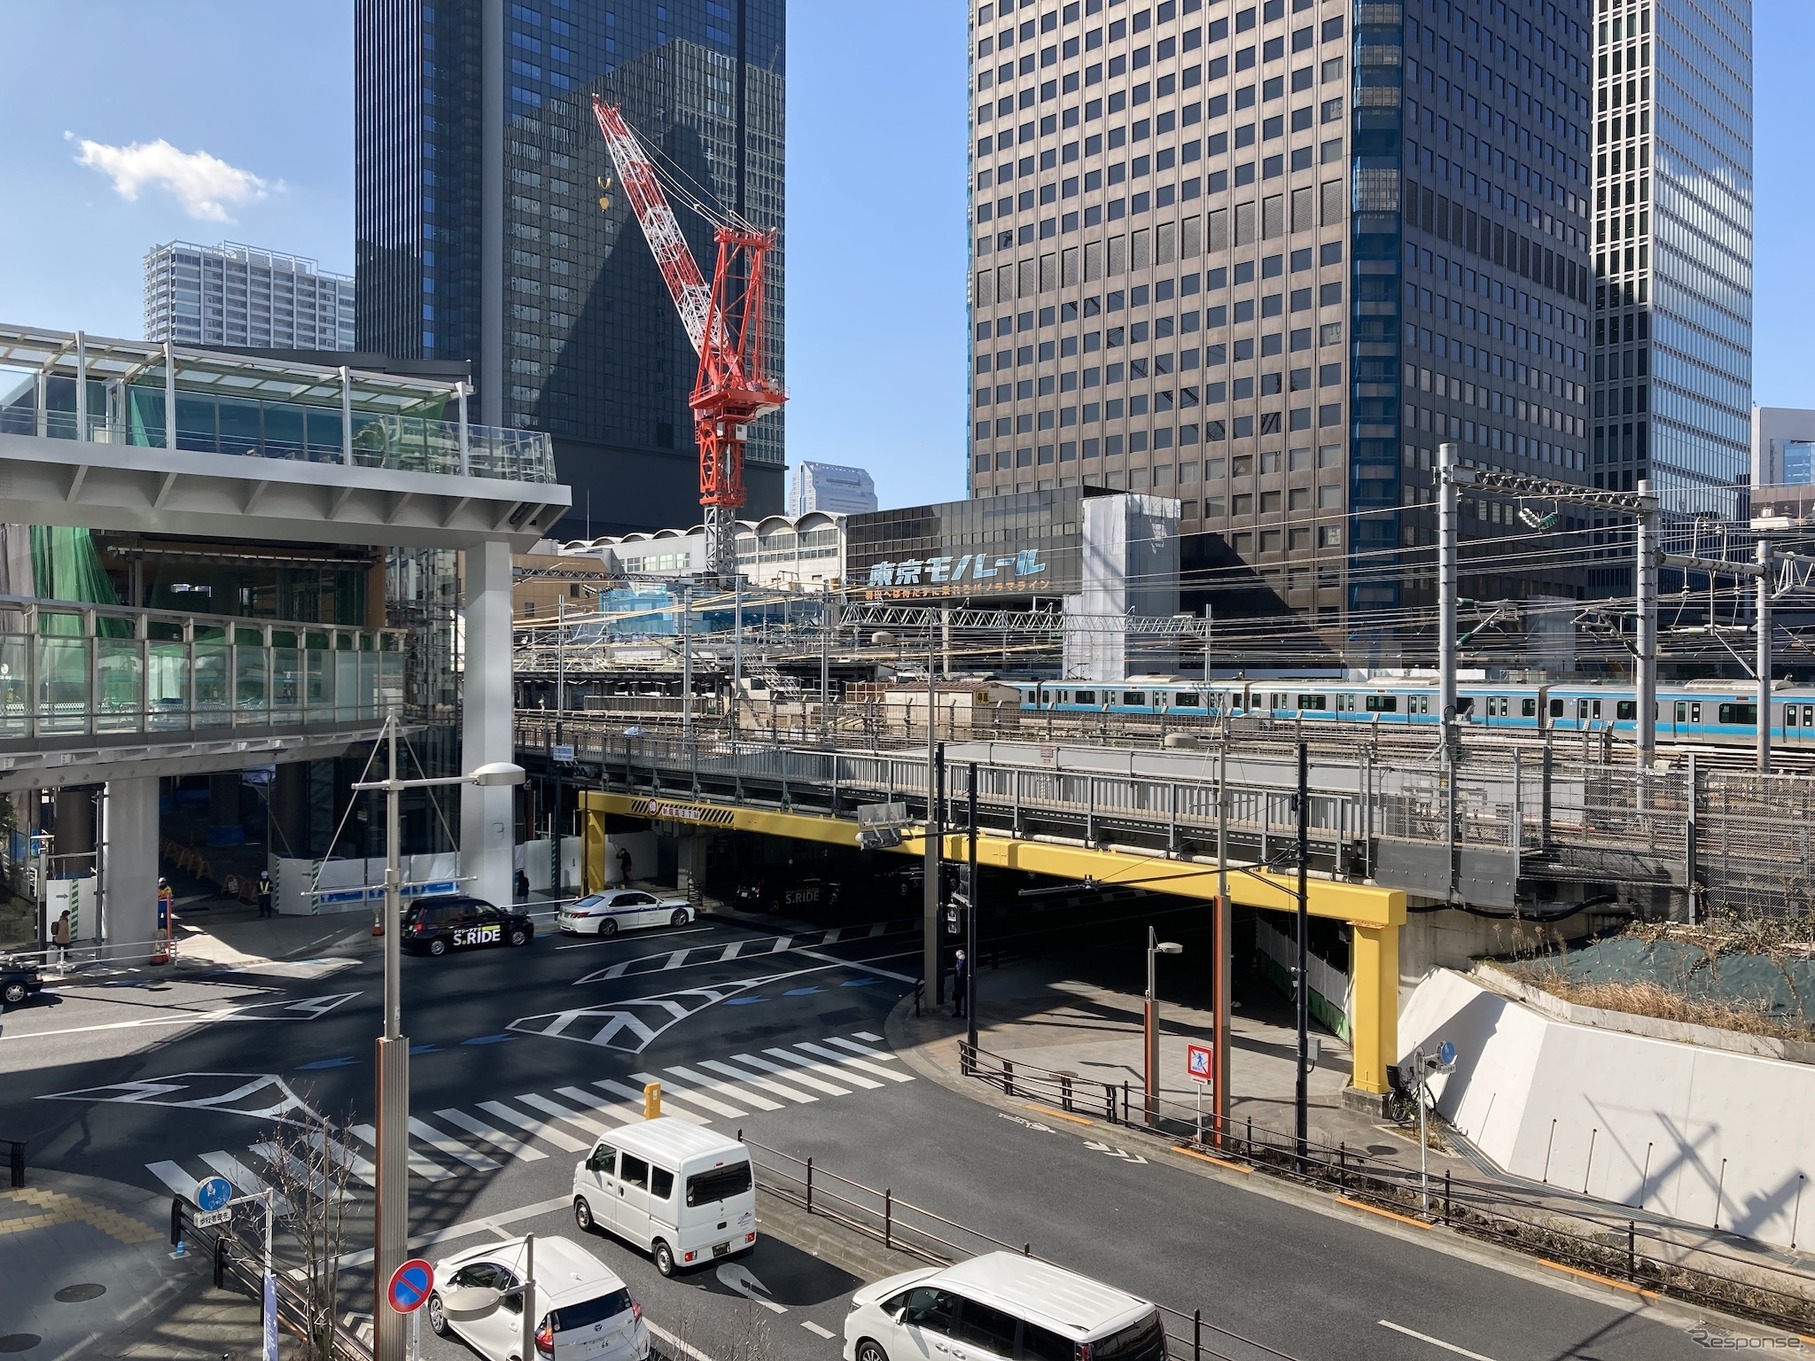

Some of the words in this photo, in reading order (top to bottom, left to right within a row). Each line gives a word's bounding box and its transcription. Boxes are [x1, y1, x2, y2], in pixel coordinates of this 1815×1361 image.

[868, 548, 1047, 587] 東京モノレール
[785, 891, 820, 904] S.RIDE
[453, 929, 501, 946] S.RIDE
